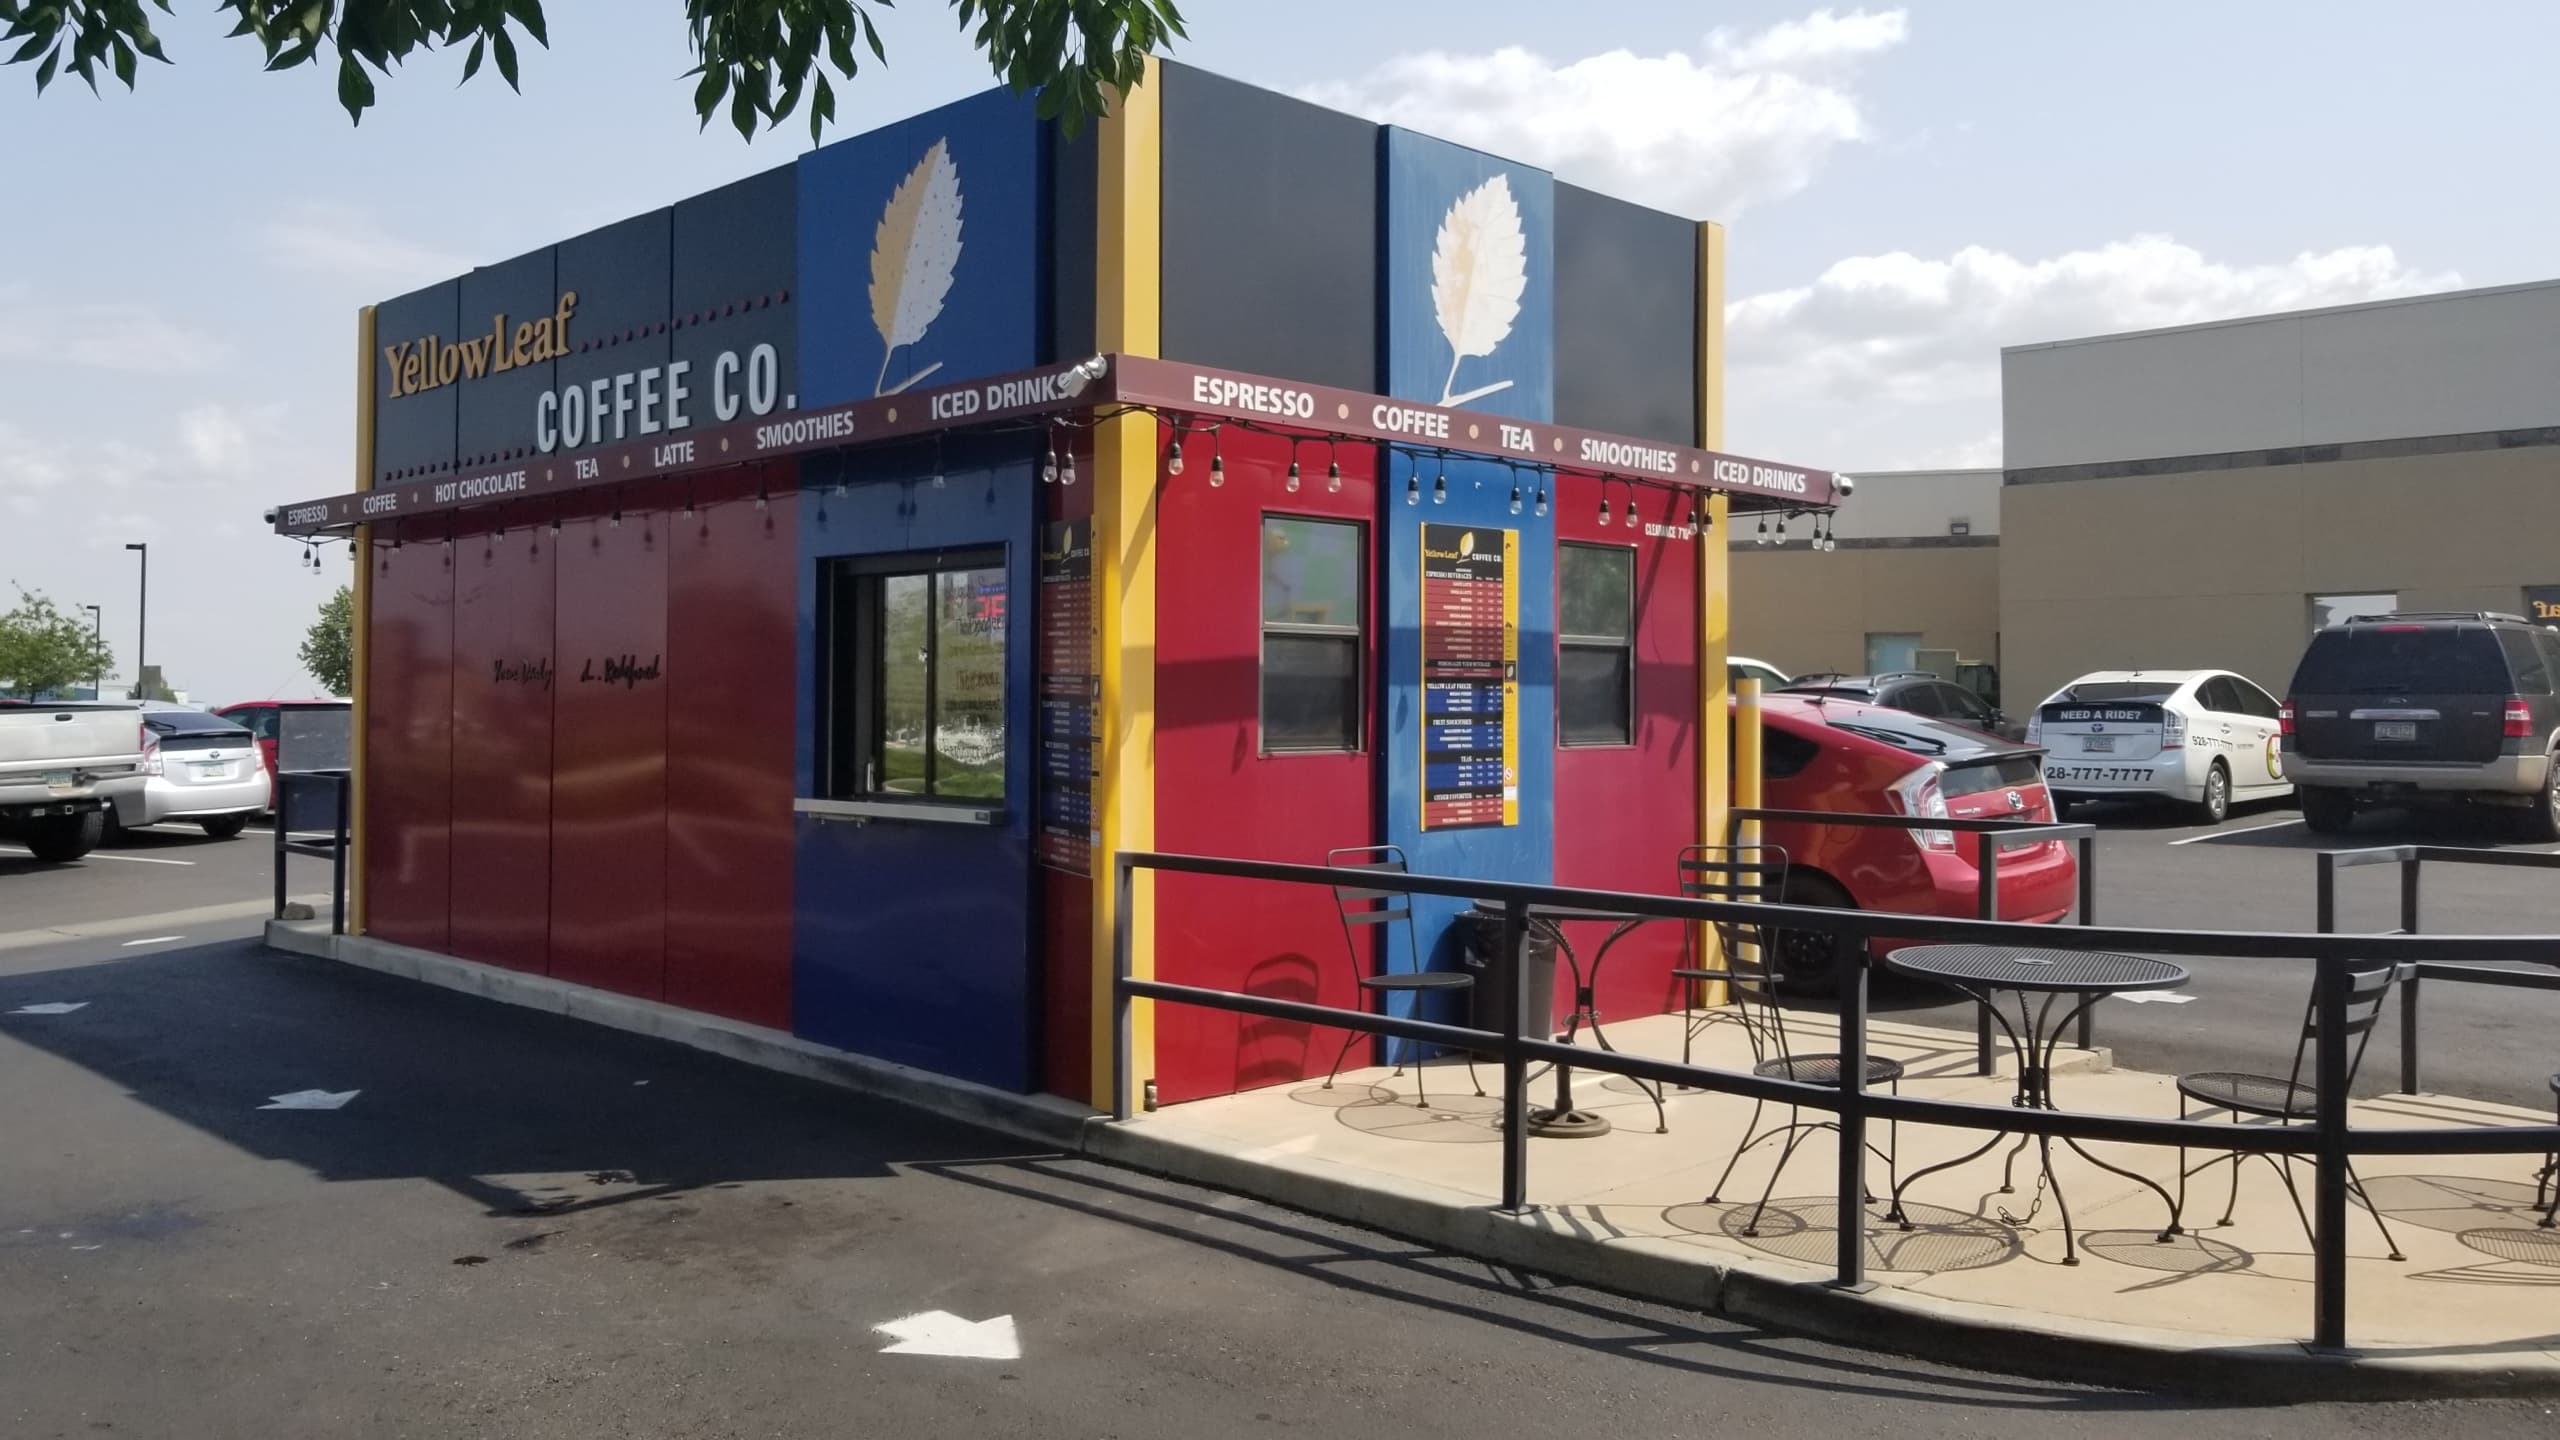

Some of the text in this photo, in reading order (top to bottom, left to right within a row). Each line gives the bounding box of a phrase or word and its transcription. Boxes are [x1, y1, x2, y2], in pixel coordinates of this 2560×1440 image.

[536, 343, 797, 454] COFFEE CO.
[931, 389, 981, 421] ICED
[1193, 375, 1315, 418] ESPRESSO
[756, 411, 855, 450] SMOOTHIES
[1372, 404, 1449, 439] COFFEE
[654, 440, 694, 468] LATTE
[1499, 424, 1535, 453] TEA
[575, 458, 599, 480] TEA
[1580, 438, 1677, 473] SMOOTHIES
[435, 470, 526, 503] HOT CHOCOLATE
[1713, 459, 1806, 493] ICED DRINKS
[287, 504, 328, 526] ESPRESSO
[362, 492, 397, 514] COFFEE
[2060, 710, 2142, 720] NEED A RIDE?
[2044, 767, 2154, 782] 28-777-7777
